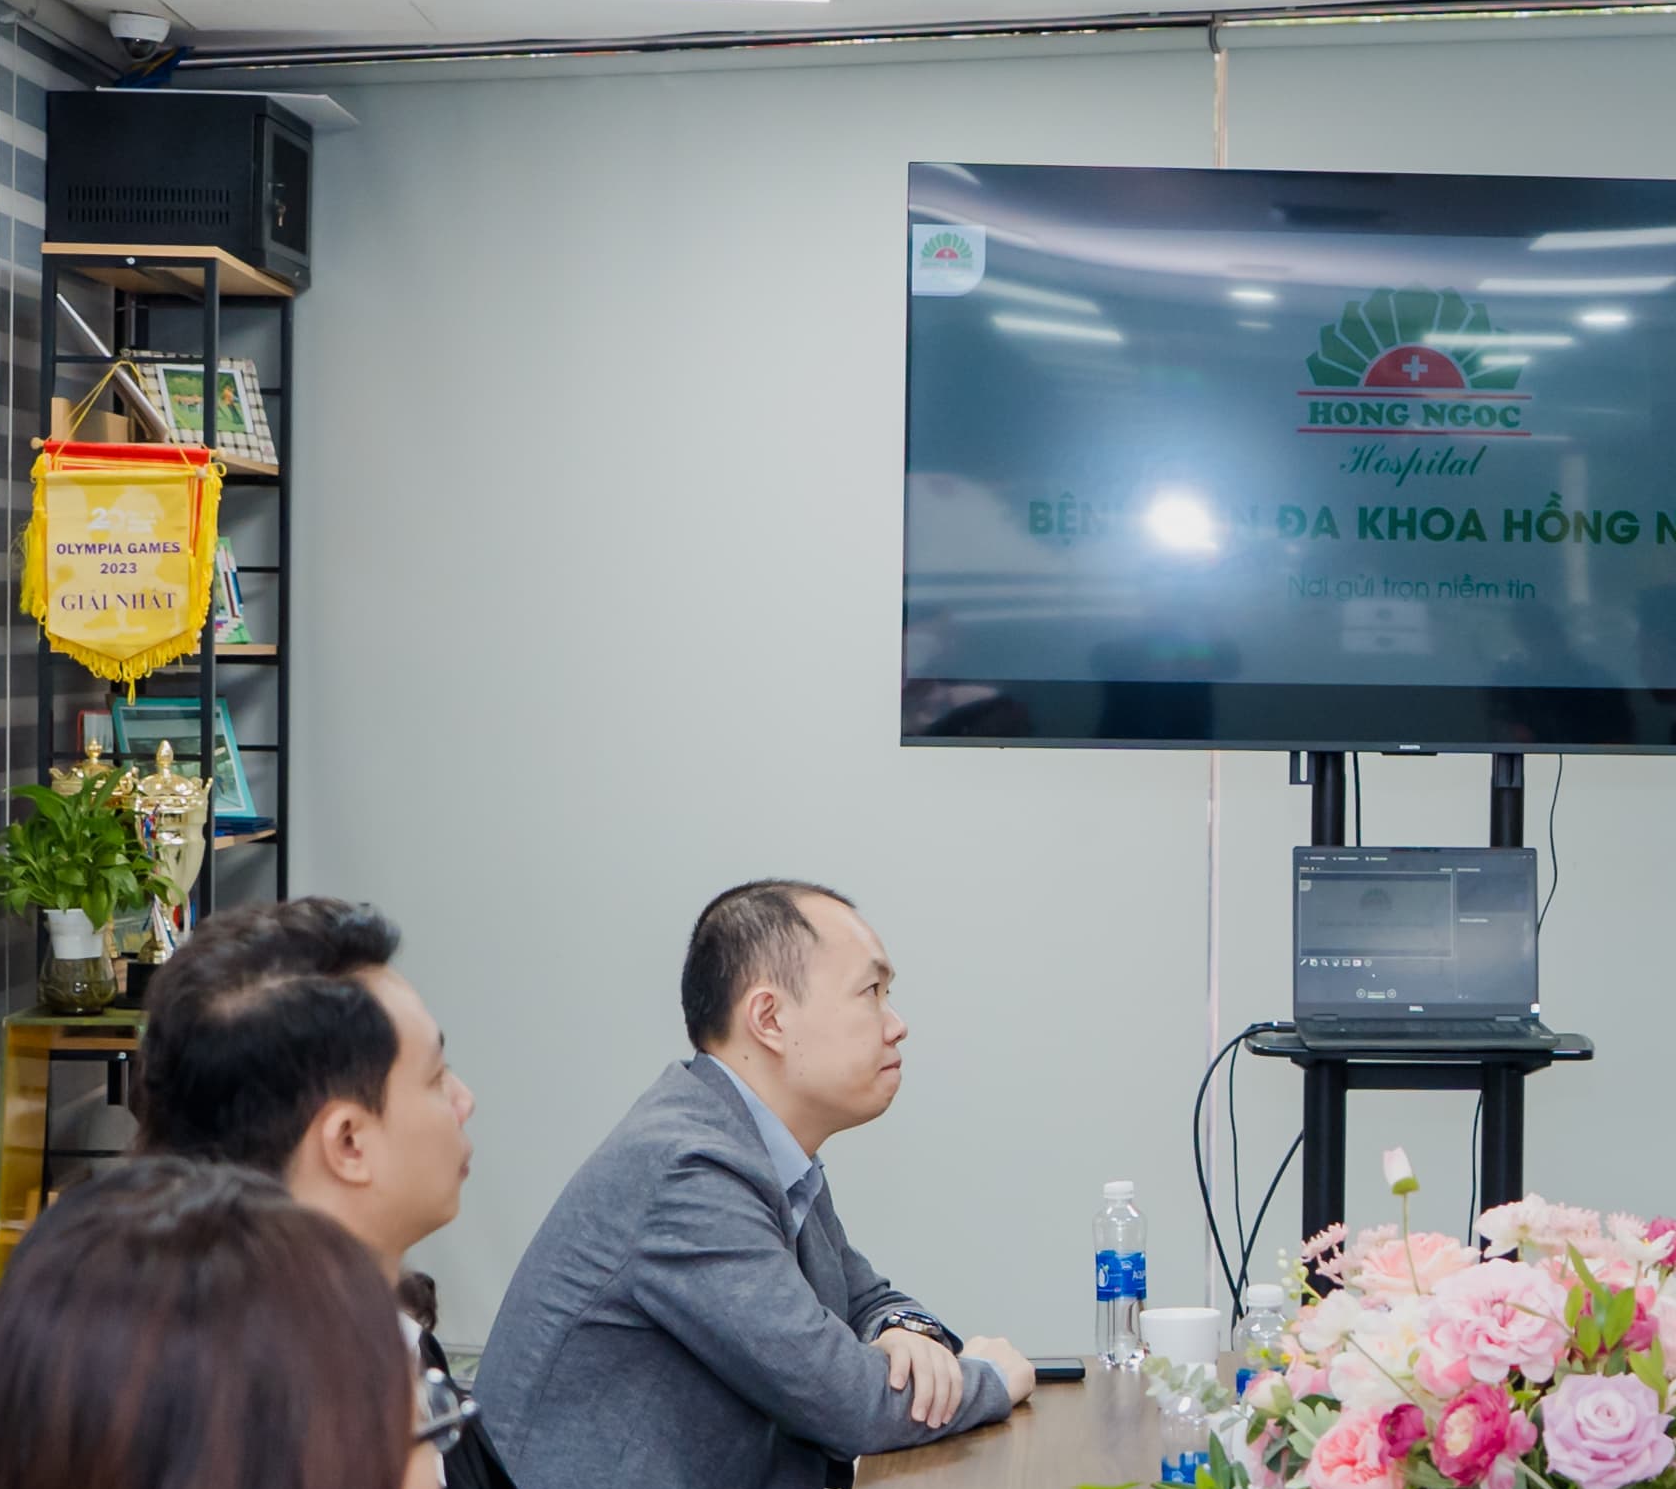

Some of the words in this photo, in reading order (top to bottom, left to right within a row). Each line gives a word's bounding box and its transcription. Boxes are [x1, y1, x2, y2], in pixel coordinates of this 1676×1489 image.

[1307, 401, 1410, 426] HONG
[1421, 403, 1522, 428] NGOC
[1339, 444, 1488, 488] Hospital
[1277, 504, 1341, 540] ĐA
[1357, 505, 1488, 542] KHOA
[1503, 492, 1641, 545] HỒNG
[56, 542, 123, 556] OLYMPIA
[127, 541, 181, 555] GAMES
[99, 562, 138, 575] 2023
